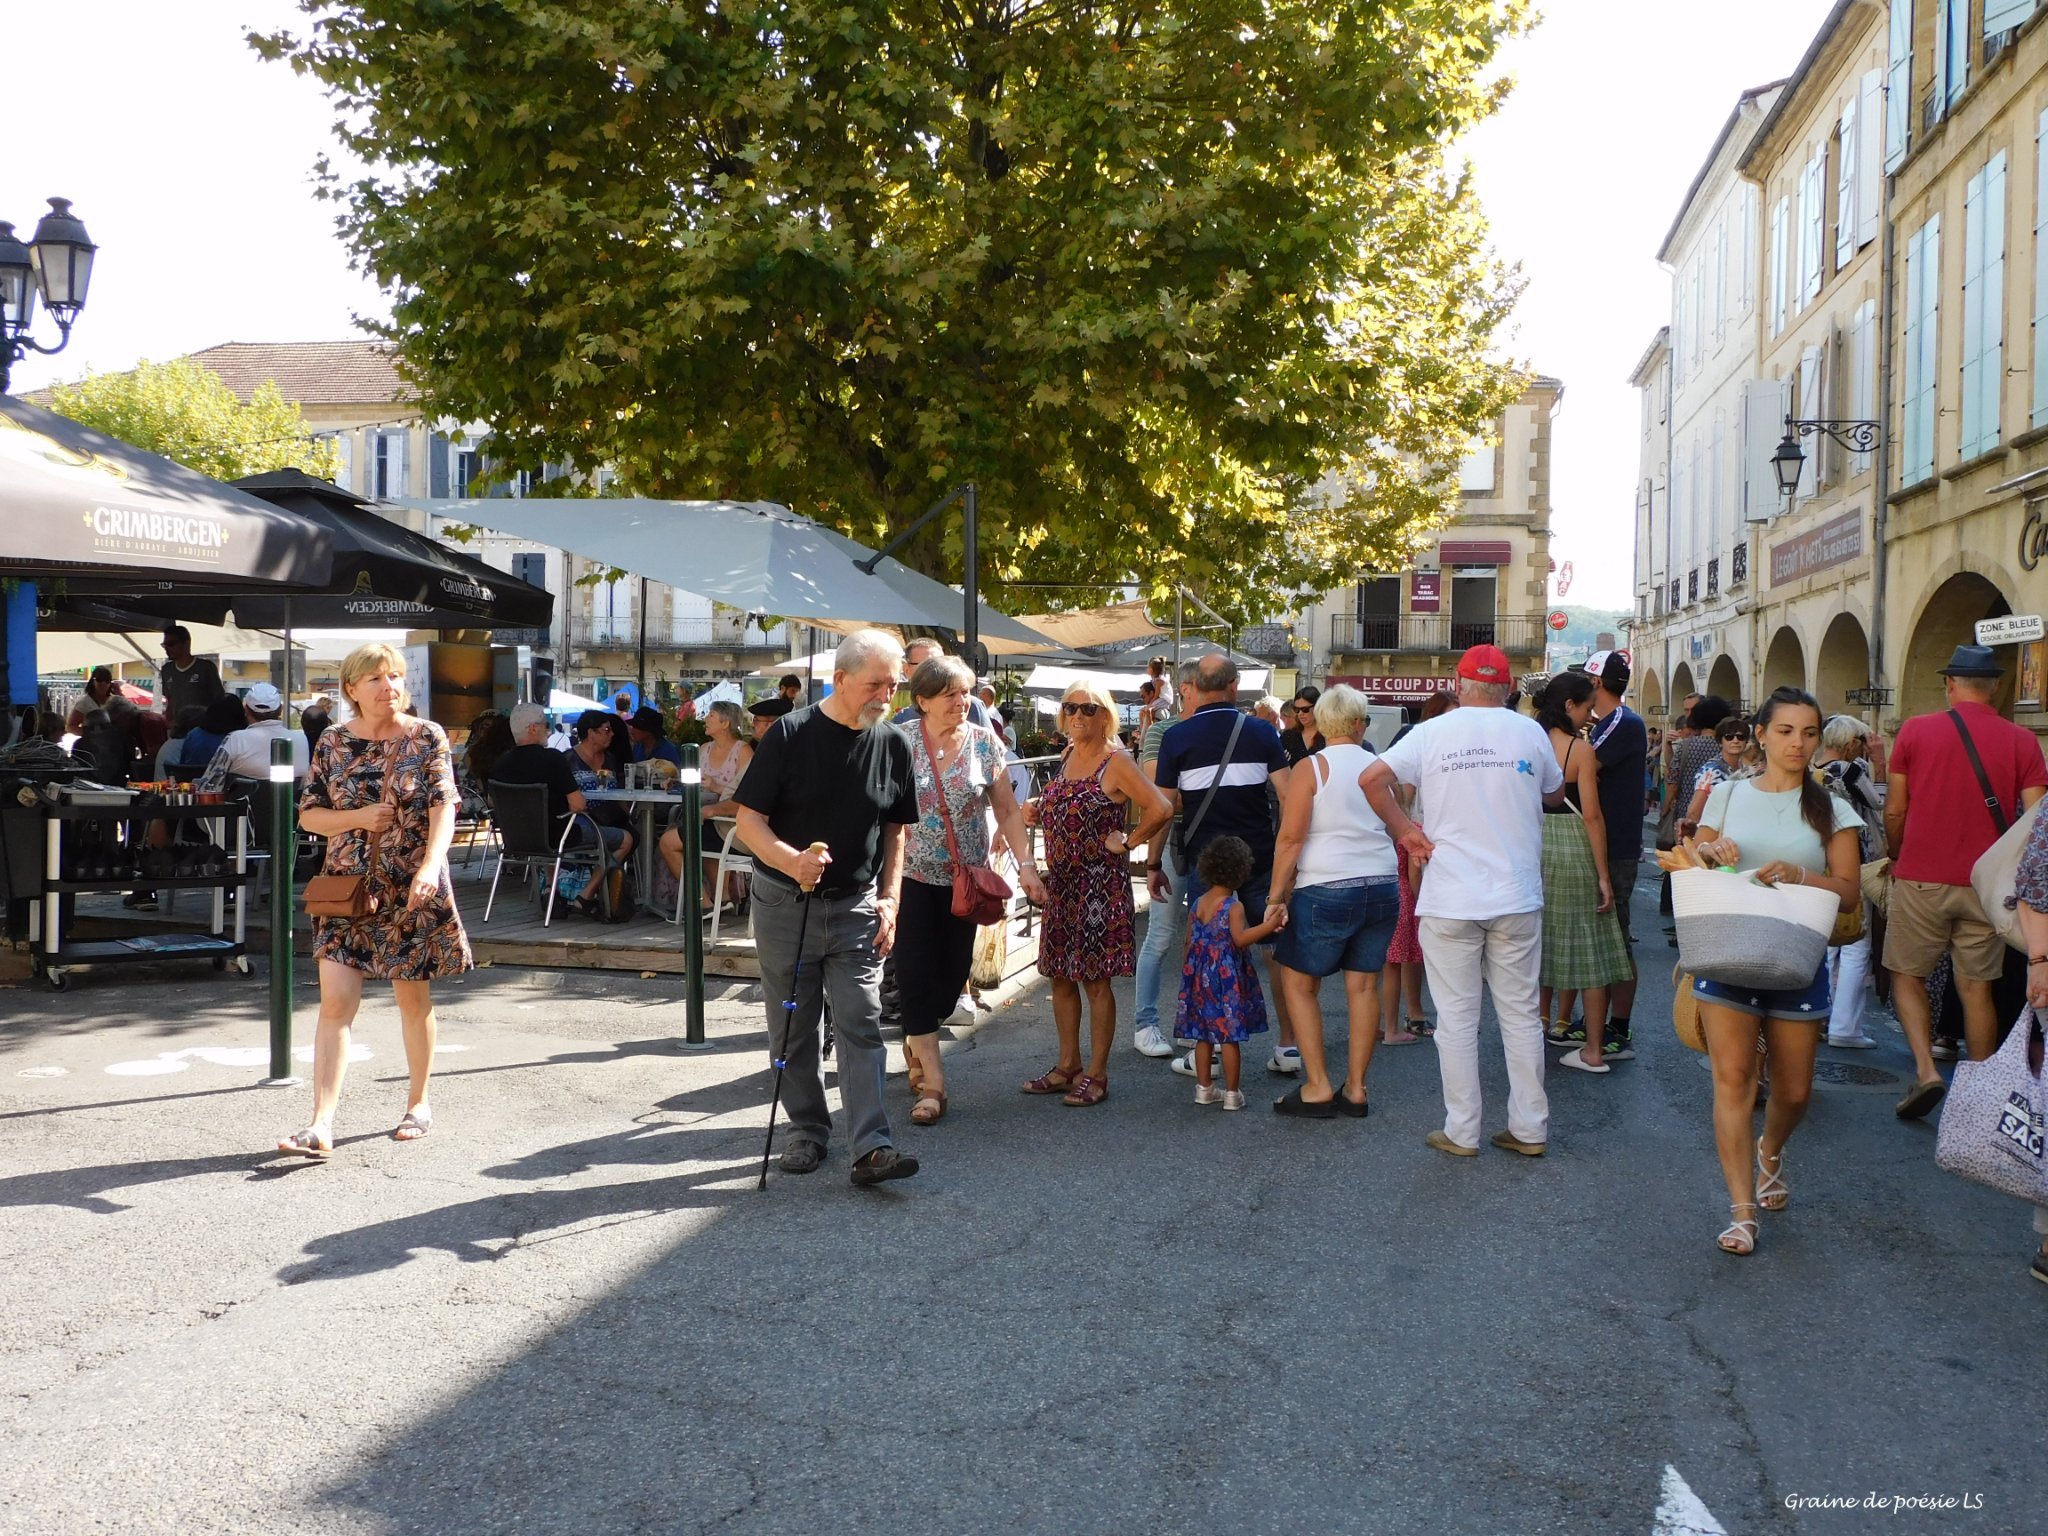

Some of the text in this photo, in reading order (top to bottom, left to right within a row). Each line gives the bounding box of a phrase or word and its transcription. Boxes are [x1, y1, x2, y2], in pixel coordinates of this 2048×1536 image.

[93, 506, 222, 547] GRIMBERGEN
[442, 577, 494, 601] GRIMBERGEN
[1979, 617, 2040, 634] ZONE BLEUE
[1980, 634, 2002, 643] DISQUE
[1588, 661, 1600, 672] 13
[679, 669, 709, 679] BNP
[1363, 678, 1381, 691] LE
[1385, 678, 1422, 691] COUP
[1442, 747, 1497, 761] Les Landes,
[1442, 760, 1515, 773] le Département
[2001, 1115, 2041, 1154] SAC
